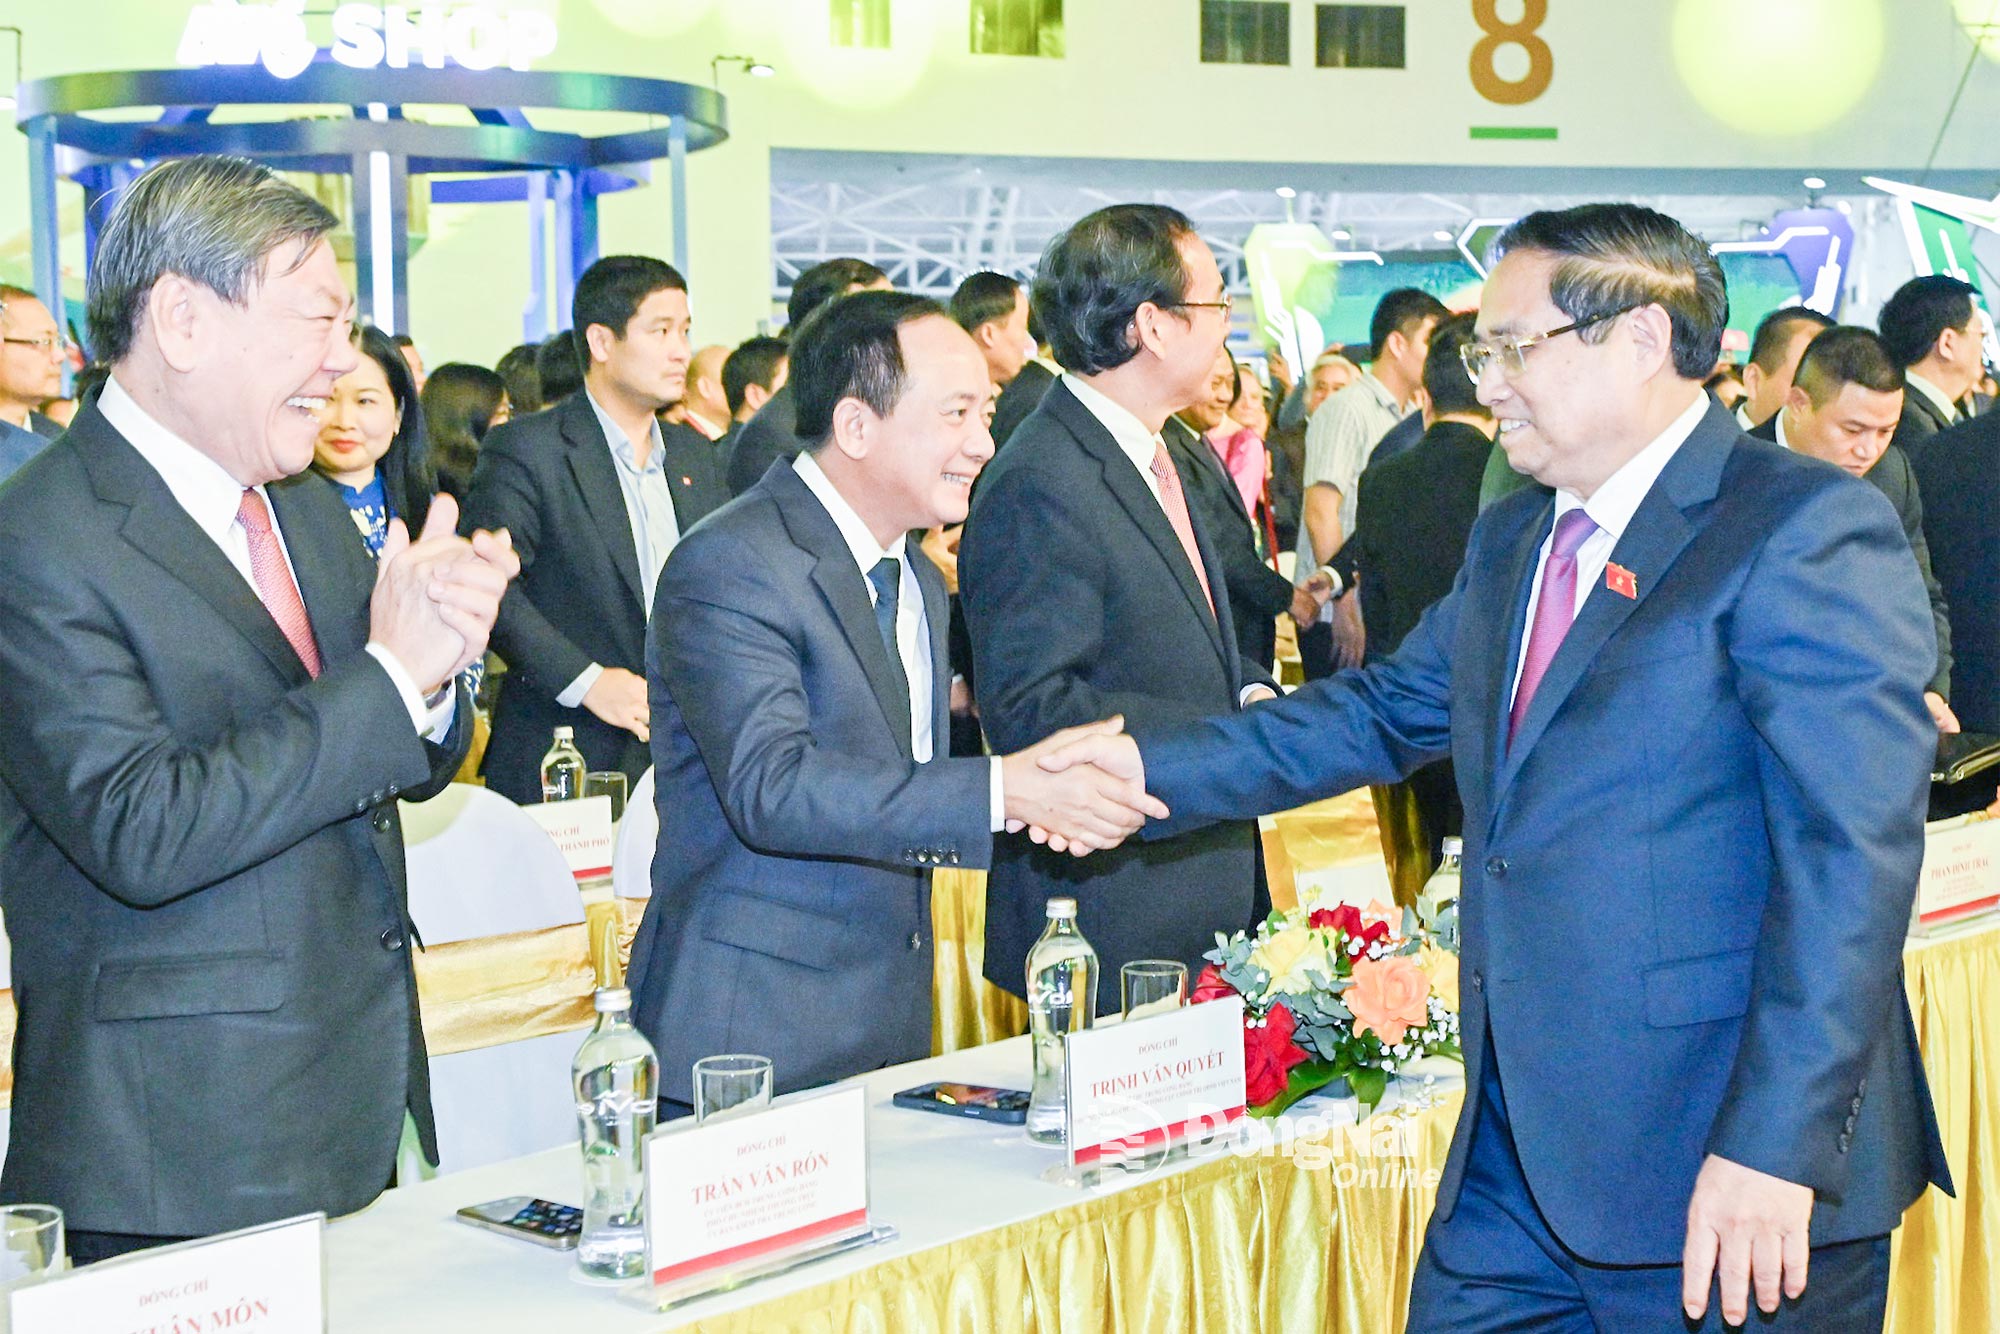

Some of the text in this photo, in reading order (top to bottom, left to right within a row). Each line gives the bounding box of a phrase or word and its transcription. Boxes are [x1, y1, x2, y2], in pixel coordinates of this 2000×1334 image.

[331, 3, 557, 71] SHOP
[1468, 0, 1554, 104] 8
[1163, 1036, 1179, 1050] CHÍ
[1090, 1072, 1138, 1099] TRỊNH
[1141, 1062, 1173, 1084] VĂN
[1175, 1047, 1225, 1079] QUYẾT
[749, 1162, 789, 1188] VĂN
[184, 1273, 209, 1295] CHÍ
